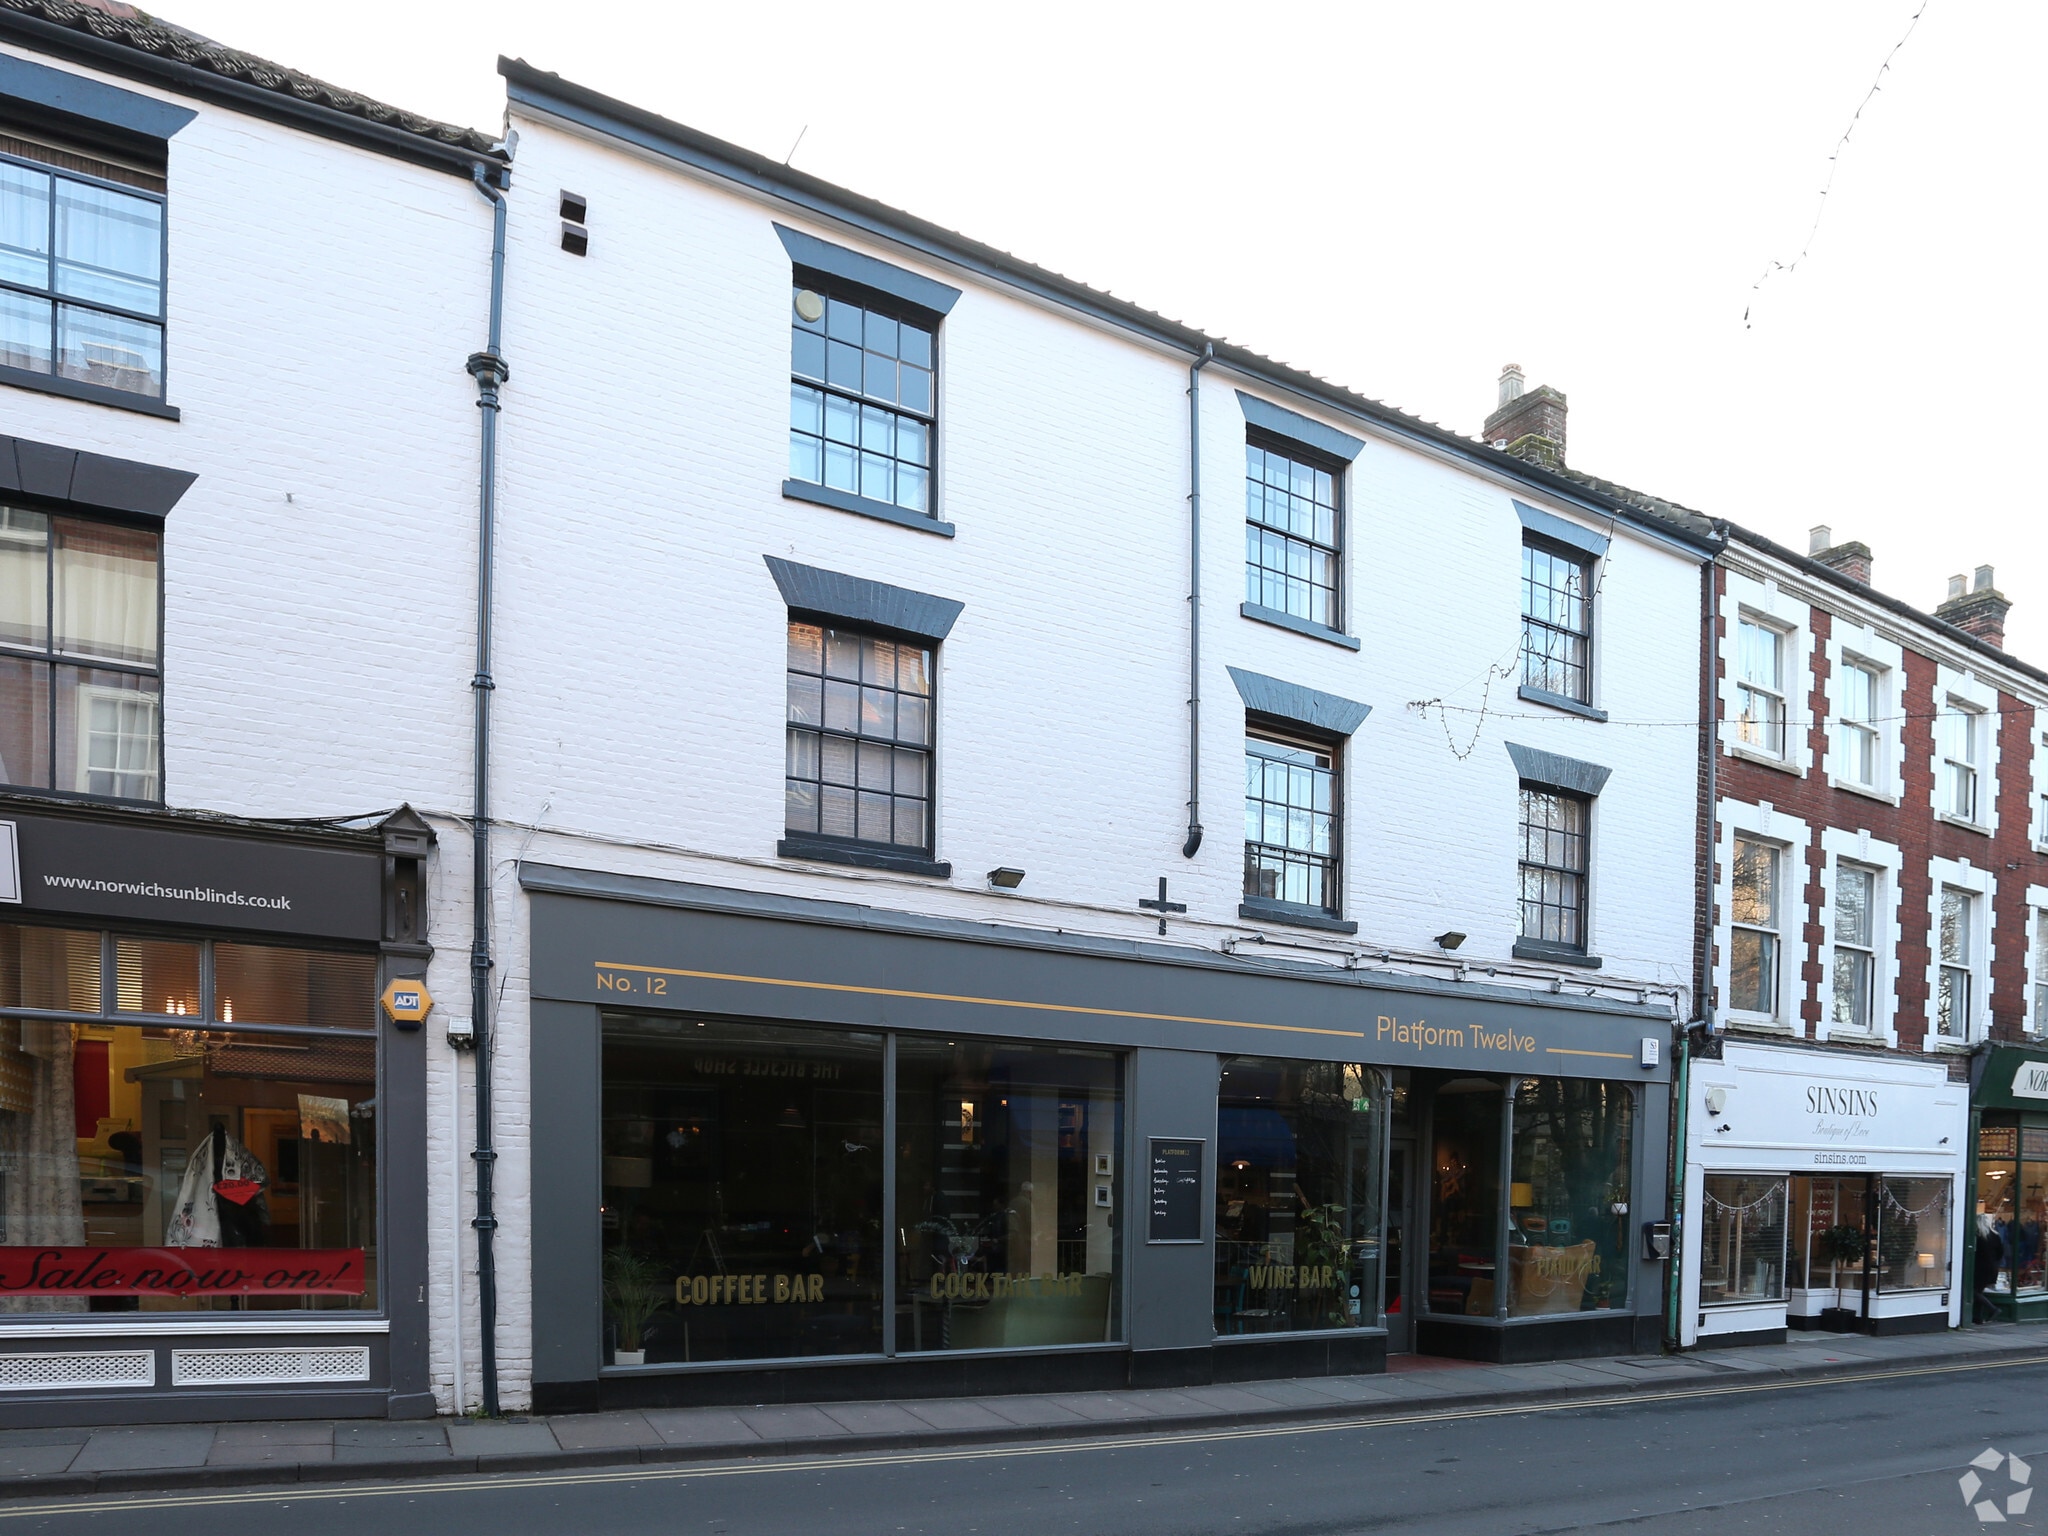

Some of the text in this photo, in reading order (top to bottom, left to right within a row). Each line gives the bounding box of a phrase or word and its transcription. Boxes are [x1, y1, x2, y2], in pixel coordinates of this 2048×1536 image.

[44, 874, 291, 910] www.norwichsunblinds.co.uk
[597, 972, 667, 995] No. 12
[395, 995, 419, 1006] ADT
[1377, 1015, 1536, 1053] Platform Twelve
[1806, 1086, 1877, 1117] SINSINS
[1814, 1152, 1867, 1164] sinsins.com
[0, 1251, 351, 1290] Sale now on!
[1249, 1265, 1333, 1289] WINE BAR
[676, 1274, 825, 1305] COFFEE BAR
[930, 1272, 1083, 1299] COCKTAIL BAR
